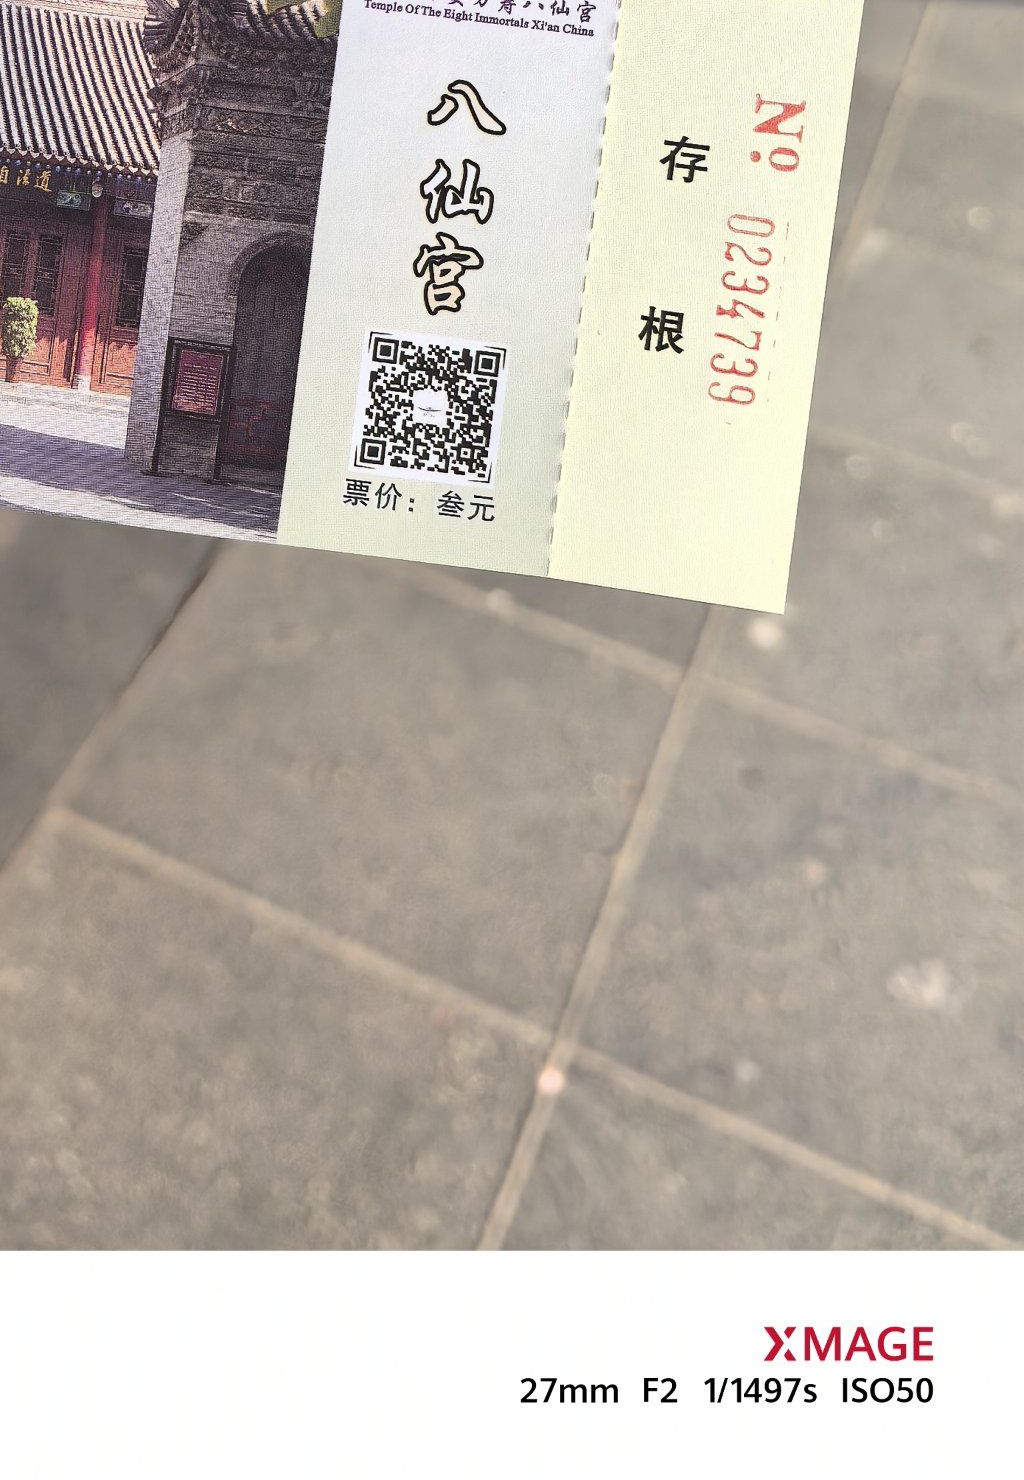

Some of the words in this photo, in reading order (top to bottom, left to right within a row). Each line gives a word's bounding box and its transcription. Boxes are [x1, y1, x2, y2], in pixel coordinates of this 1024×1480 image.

[405, 3, 422, 15] Of
[420, 5, 442, 18] The
[443, 9, 473, 23] Eight
[474, 12, 529, 29] Immortals
[531, 20, 560, 33] Xi'an
[562, 24, 595, 37] China
[413, 79, 507, 315] 八仙宫
[708, 213, 776, 406] 0234739
